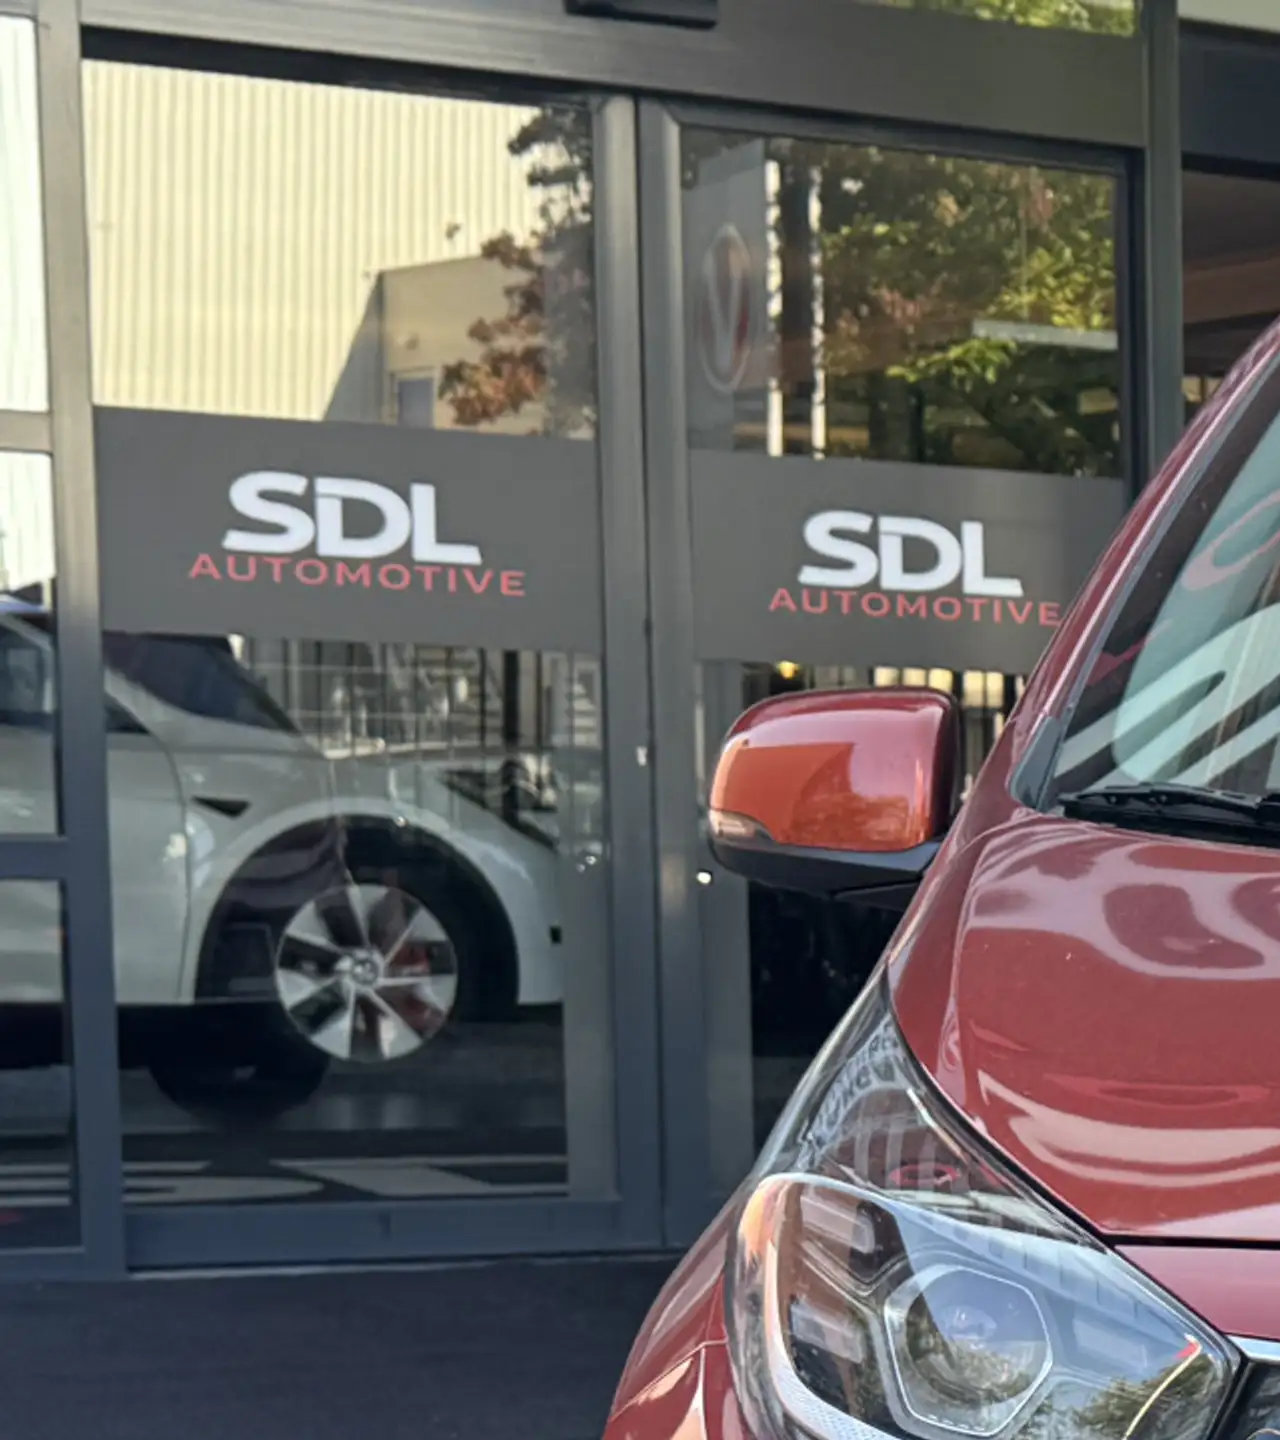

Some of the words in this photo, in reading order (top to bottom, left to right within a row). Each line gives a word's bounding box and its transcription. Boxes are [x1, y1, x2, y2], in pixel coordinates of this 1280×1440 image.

[221, 470, 483, 566] SDL
[188, 552, 526, 597] AUTOMOTIVE
[797, 510, 1024, 597] SDL
[768, 587, 1062, 628] AUTOMOTIVE
